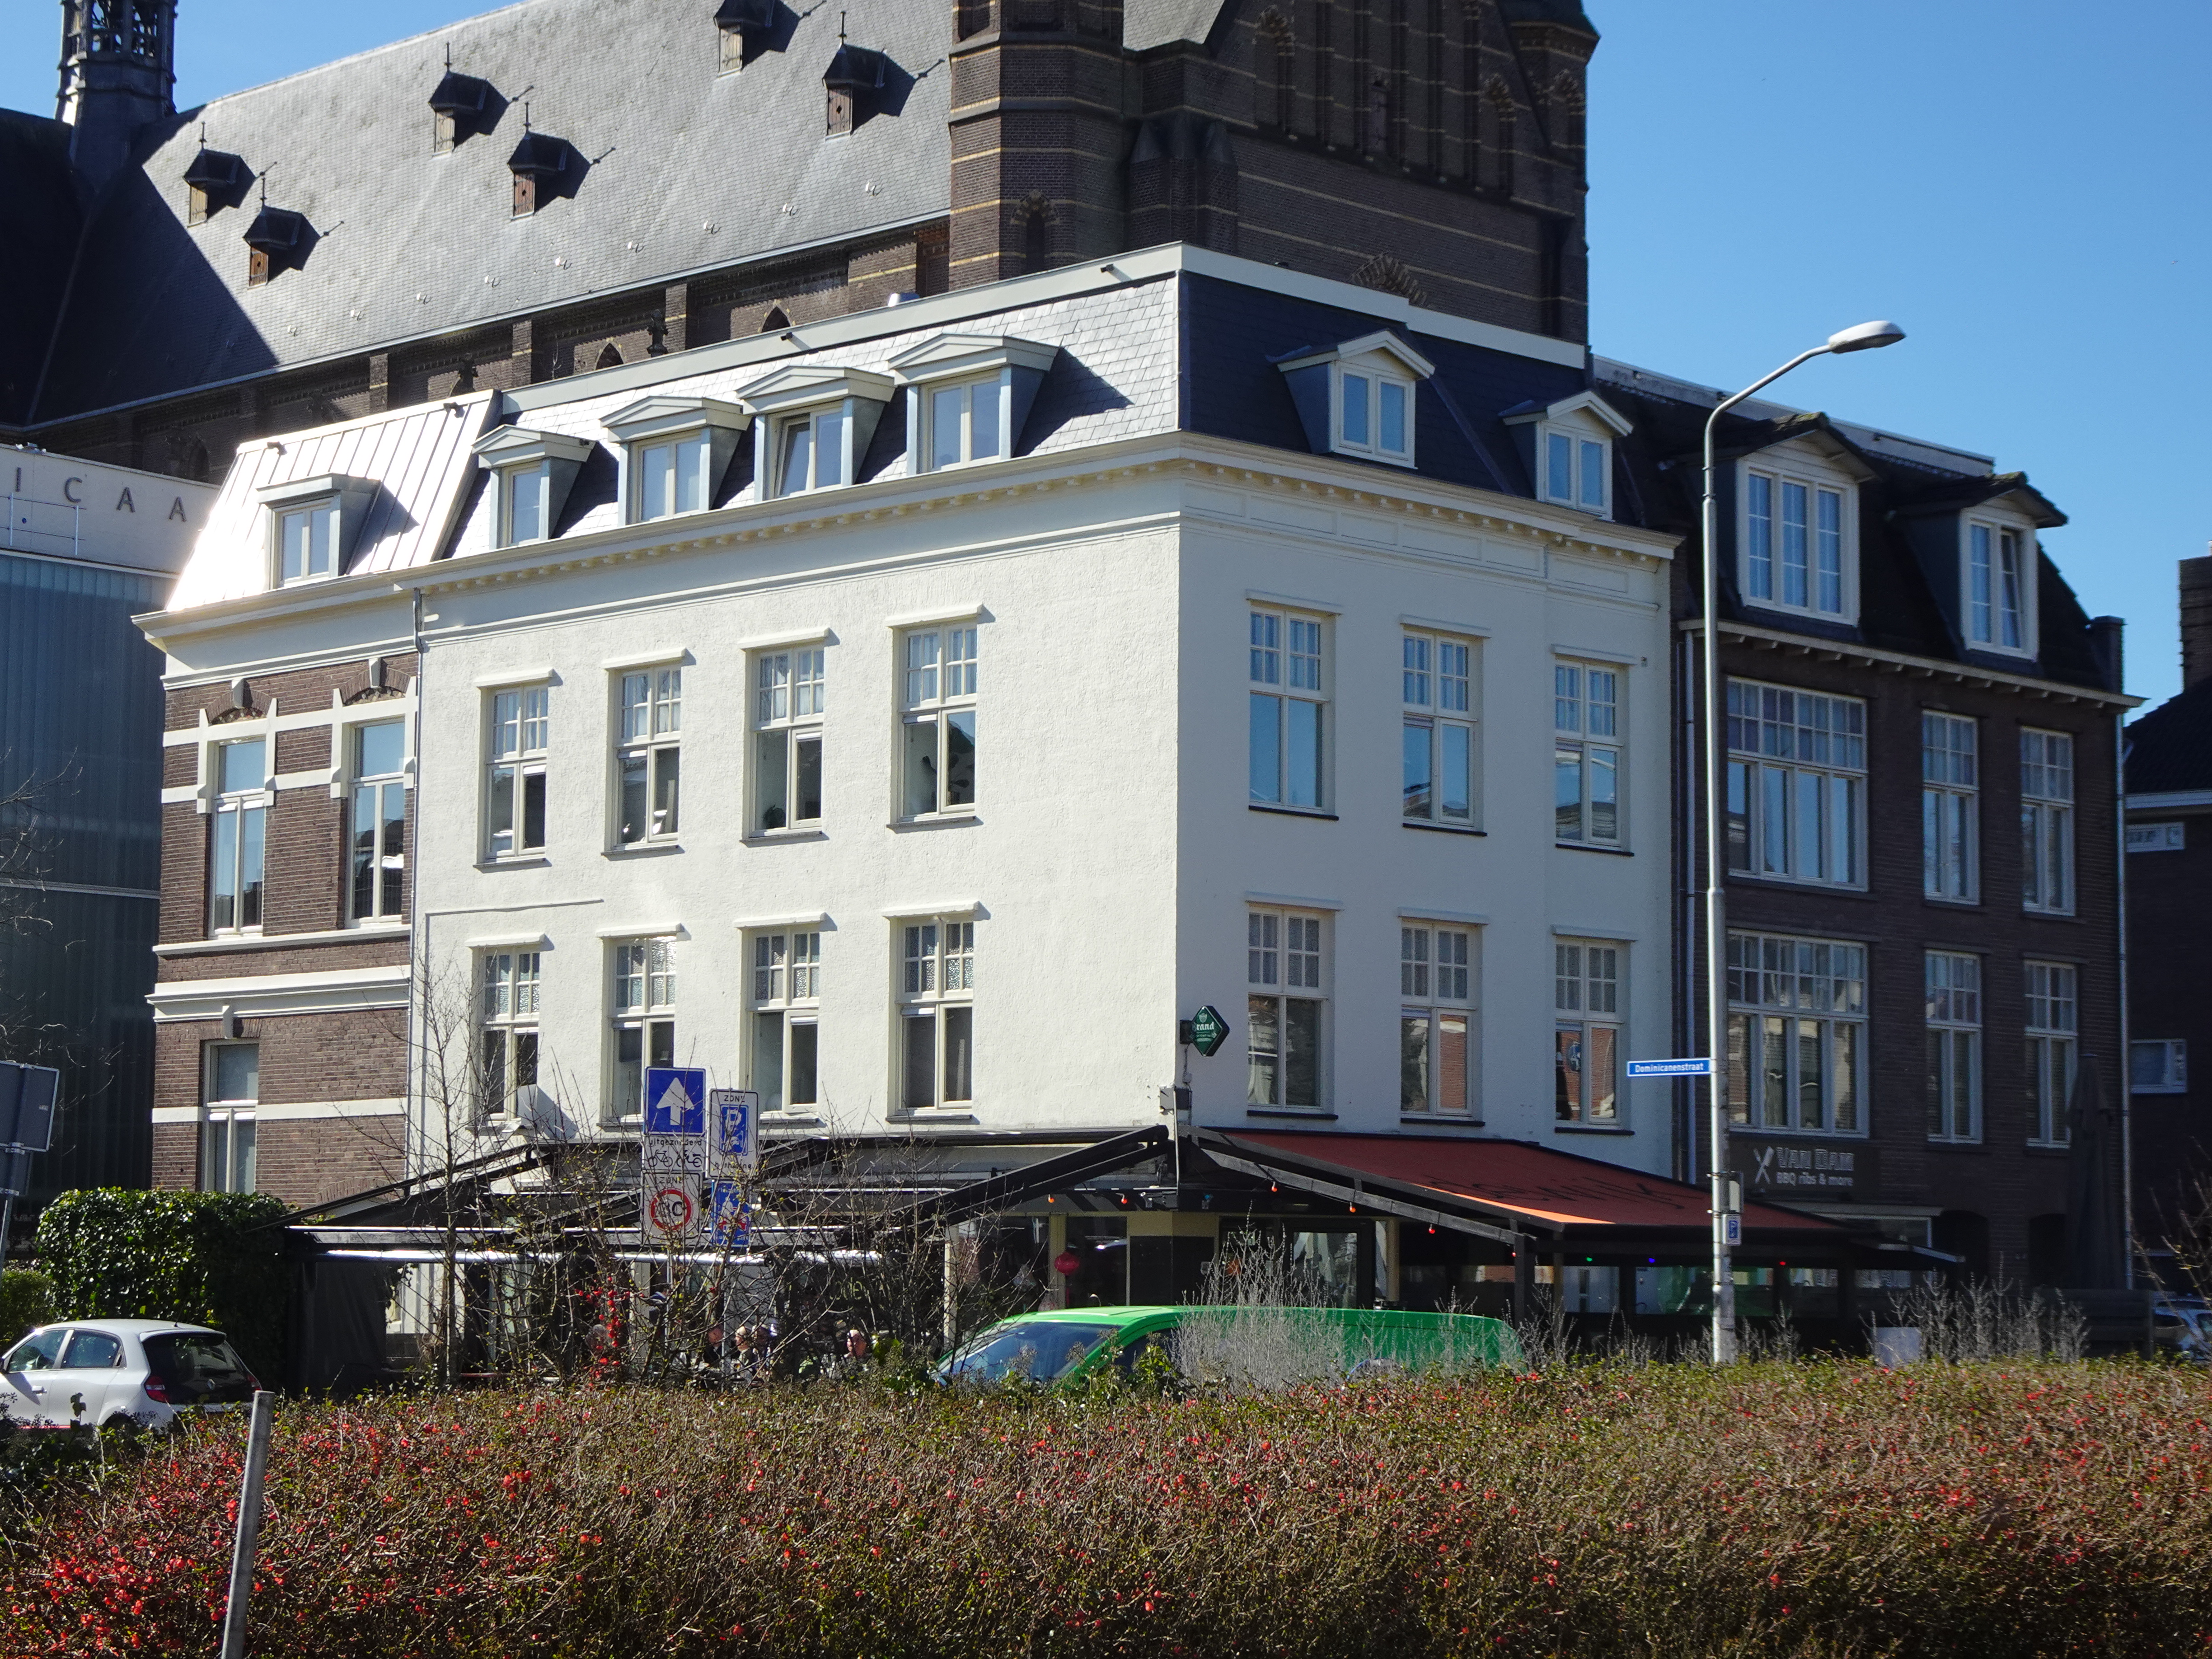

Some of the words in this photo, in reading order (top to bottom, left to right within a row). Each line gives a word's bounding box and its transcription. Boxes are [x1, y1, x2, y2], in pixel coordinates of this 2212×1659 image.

[1192, 1022, 1214, 1031] Brand
[1635, 1063, 1704, 1073] Dominicanenstraat
[1776, 1147, 1811, 1169] VAN
[1776, 1172, 1796, 1186] BBQ
[1798, 1172, 1816, 1185] ribs
[1819, 1173, 1826, 1185] &
[1828, 1176, 1853, 1186] more
